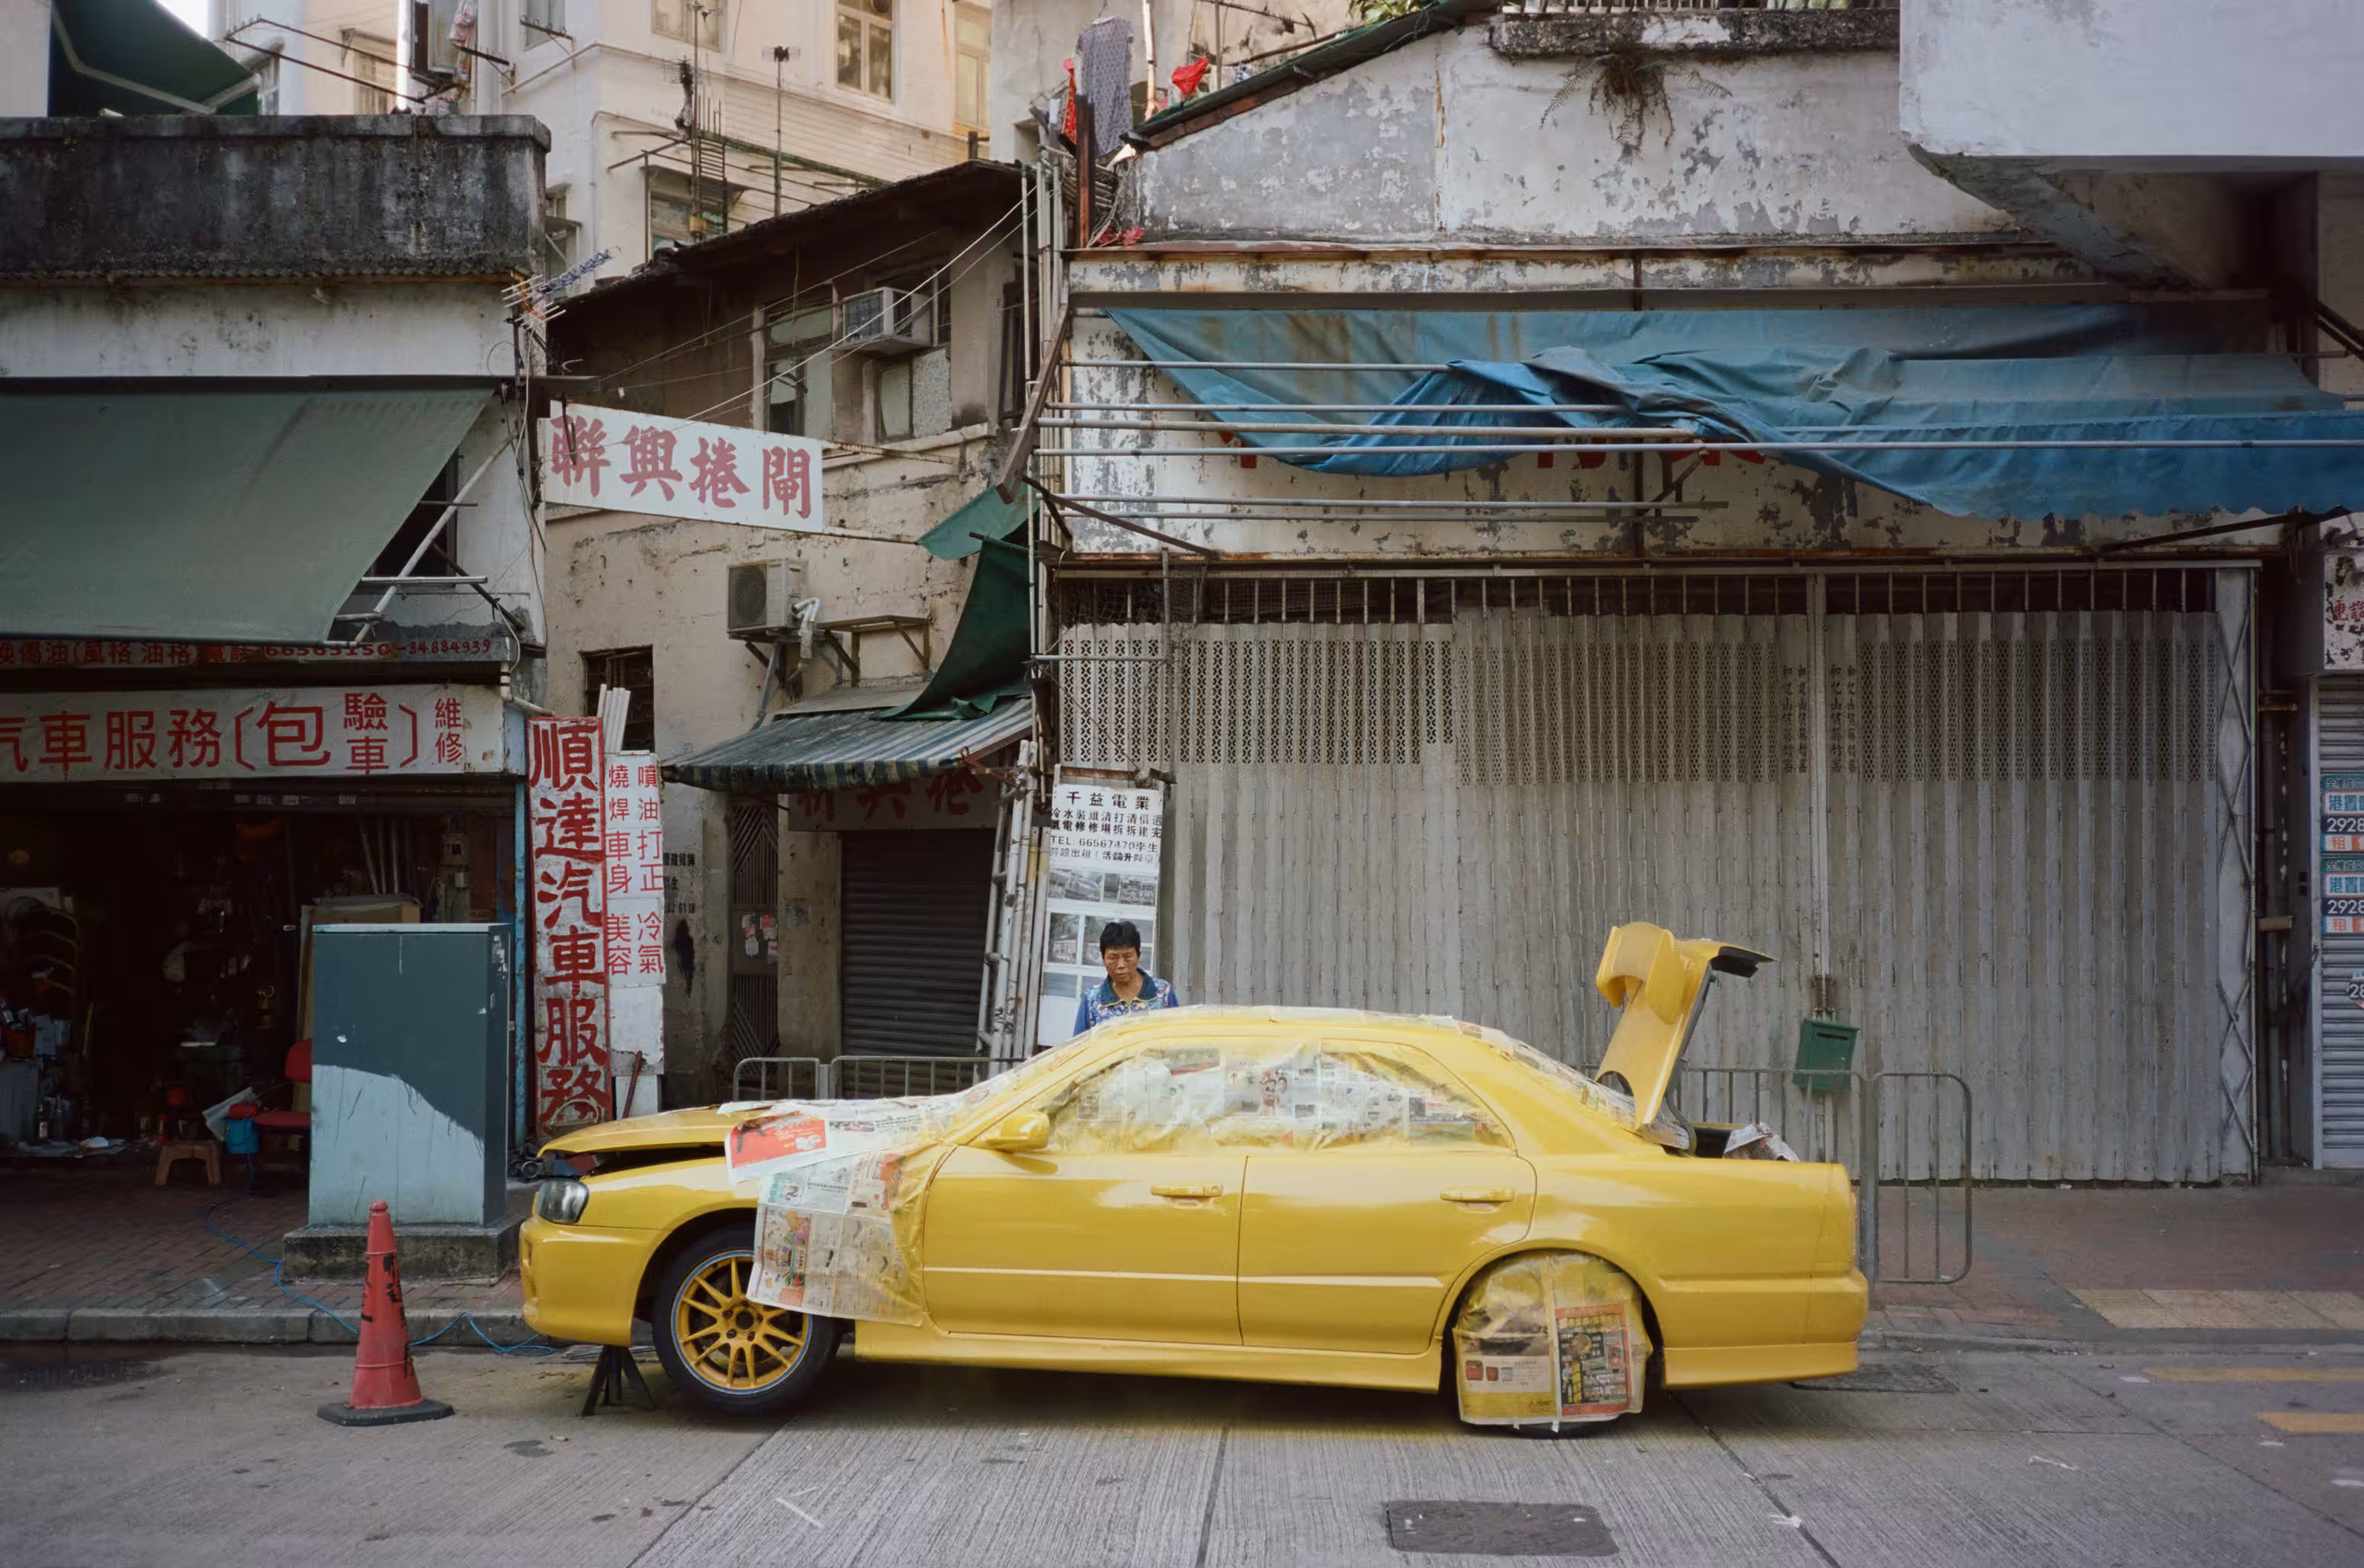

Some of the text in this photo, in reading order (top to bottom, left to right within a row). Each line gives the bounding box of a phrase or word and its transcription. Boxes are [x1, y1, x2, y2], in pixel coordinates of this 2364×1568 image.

[551, 414, 811, 519] 聯興捲閘
[1066, 791, 1150, 811] 千益電業
[531, 722, 609, 1135] 順達汽車服務
